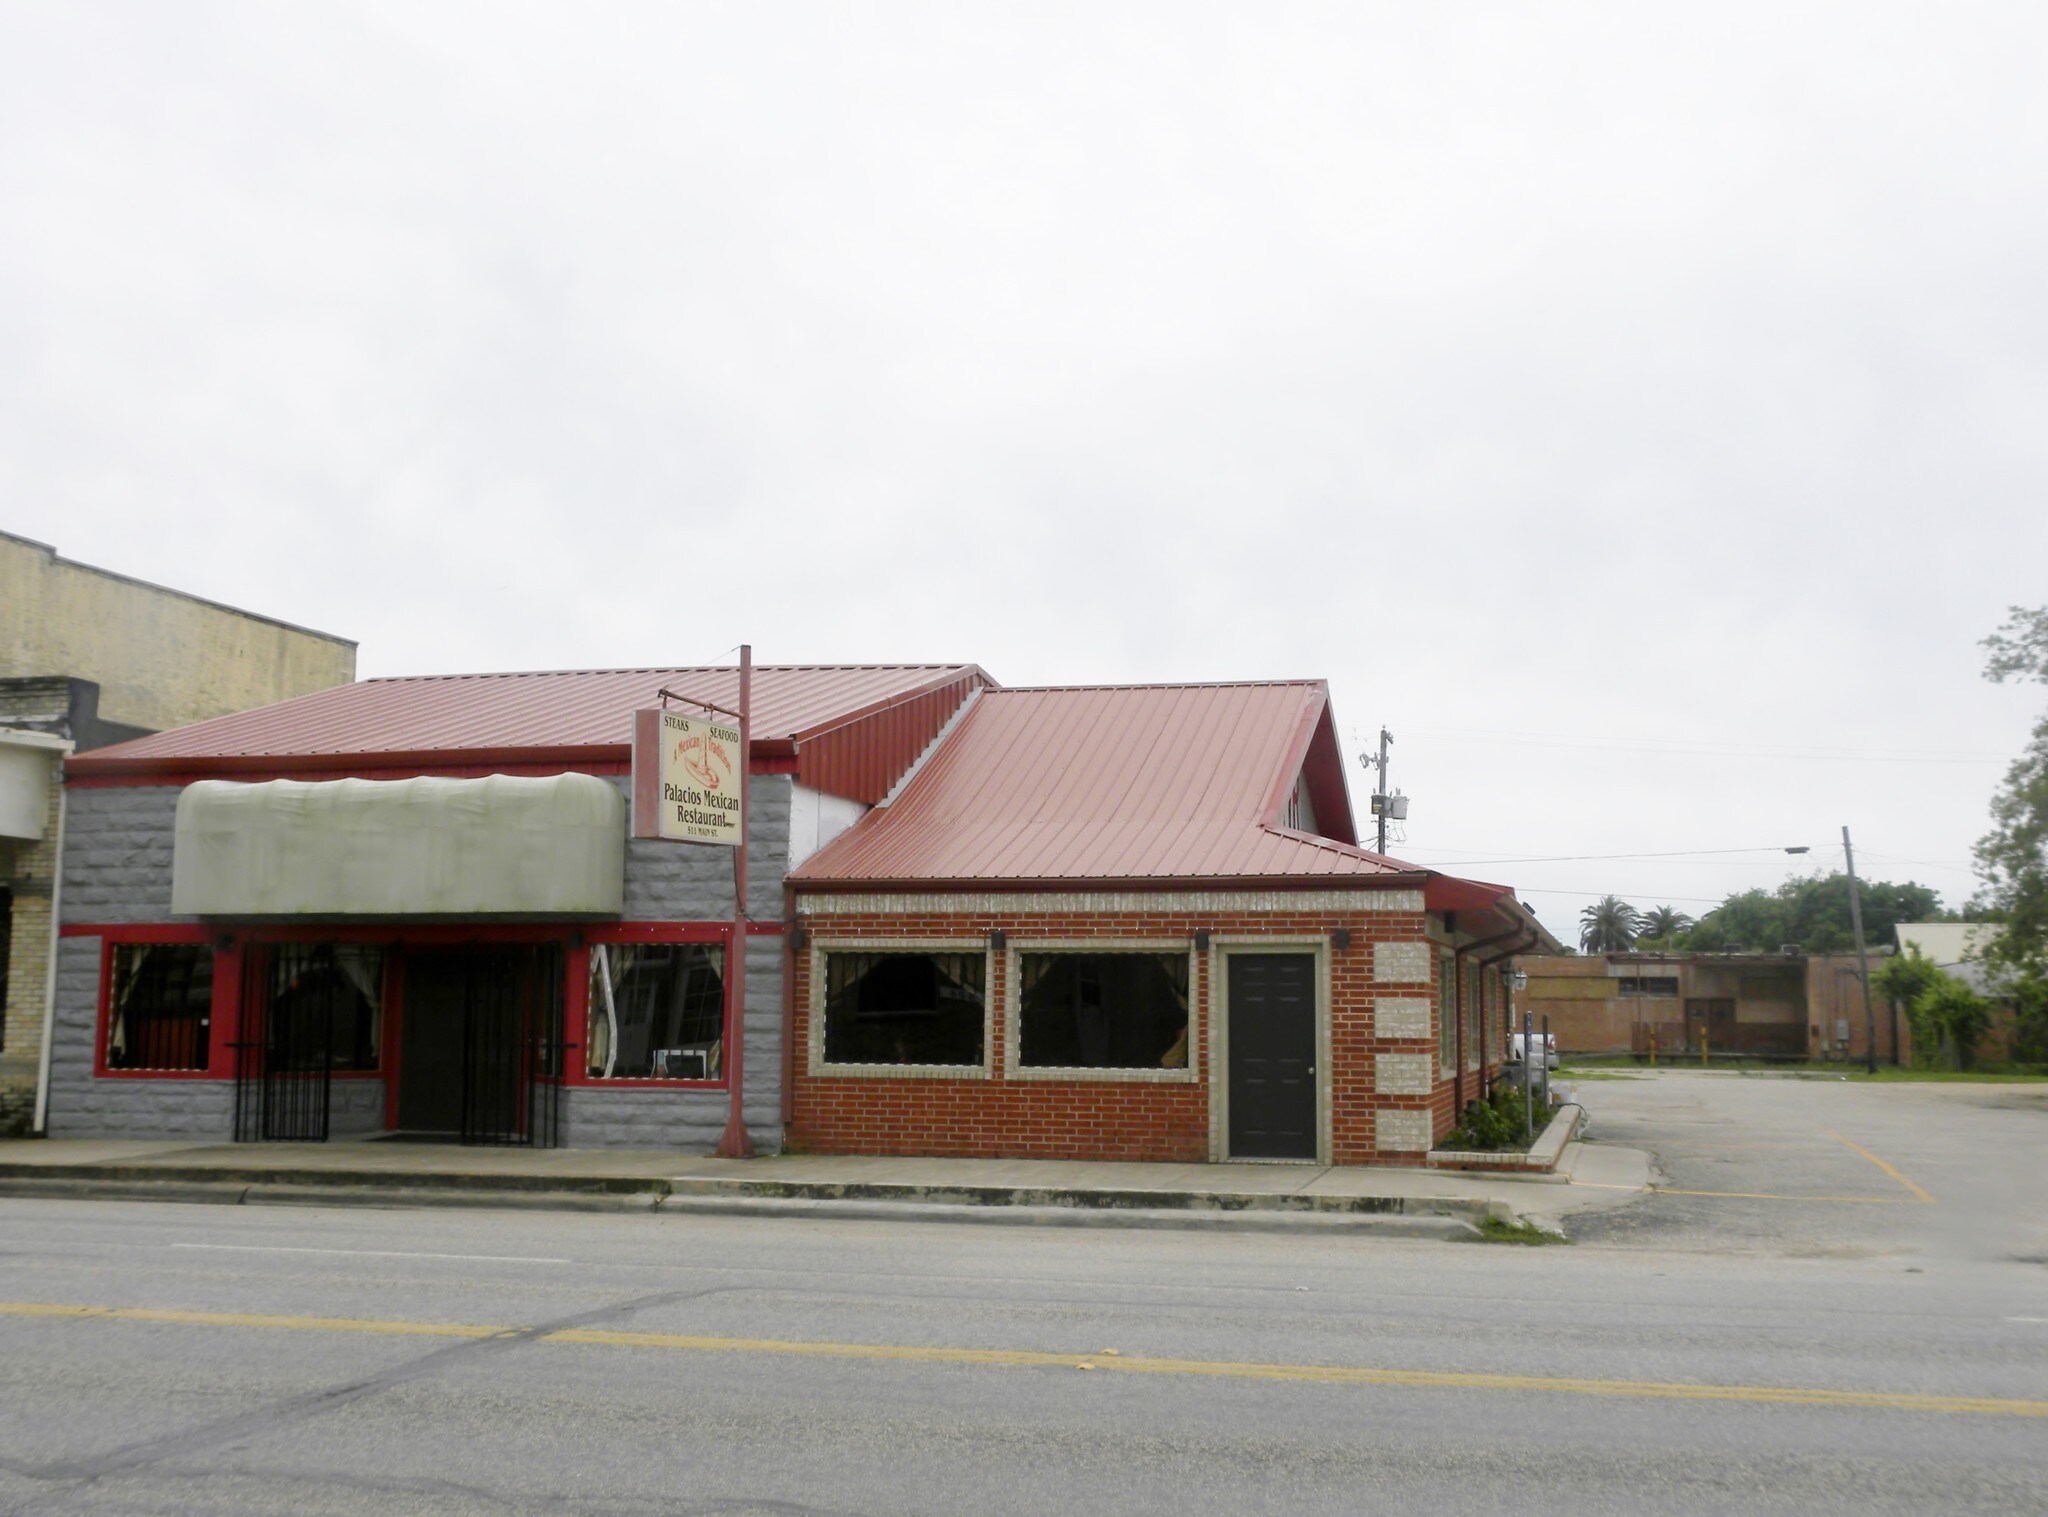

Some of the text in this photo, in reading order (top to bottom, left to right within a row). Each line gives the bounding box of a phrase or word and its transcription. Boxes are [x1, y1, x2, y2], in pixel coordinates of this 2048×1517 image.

[664, 715, 689, 732] STEAKS
[709, 726, 739, 743] SEAFOOD
[664, 782, 739, 811] Palacios Mexican
[677, 805, 728, 828] Restaurant
